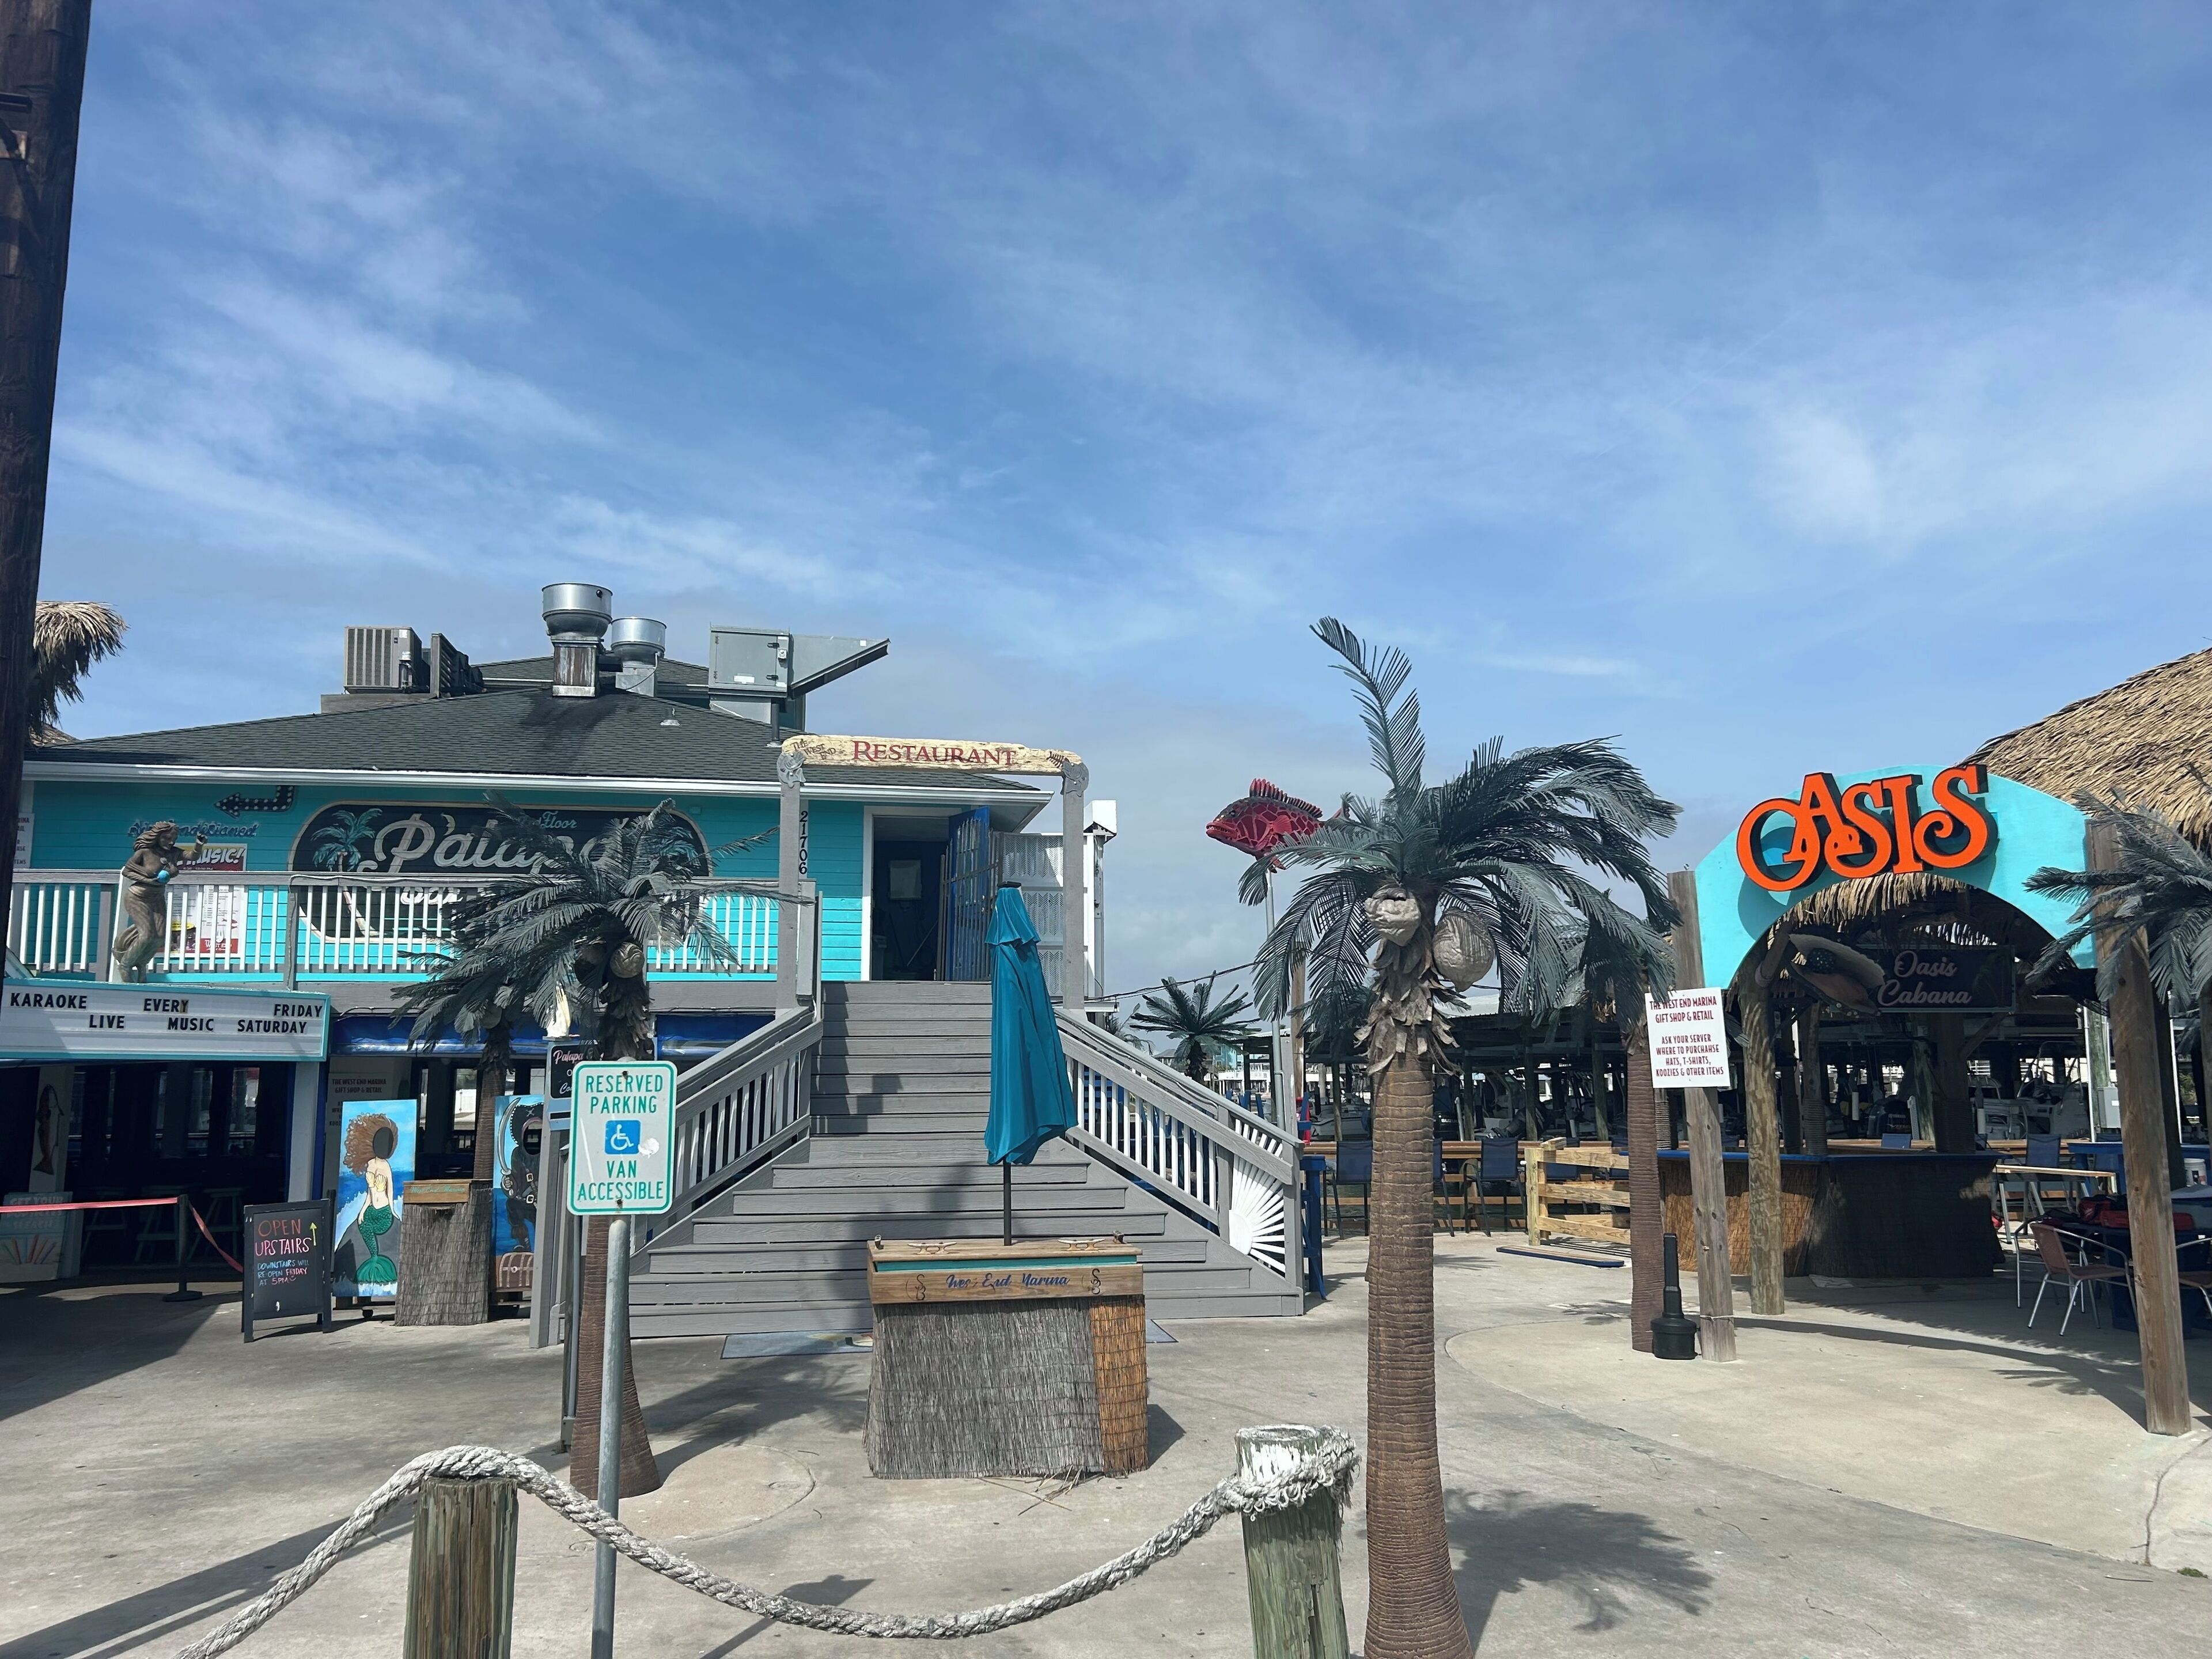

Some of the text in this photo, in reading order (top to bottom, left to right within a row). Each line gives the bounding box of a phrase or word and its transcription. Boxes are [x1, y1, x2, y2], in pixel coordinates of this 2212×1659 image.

[790, 740, 809, 752] THE
[803, 743, 825, 755] WEST
[815, 748, 836, 760] END
[851, 740, 1017, 766] RESTAURANT
[541, 810, 577, 829] Floor
[1736, 764, 1988, 891] OASIS
[798, 810, 809, 874] 21706
[1894, 950, 1958, 978] Oasis
[1877, 979, 1972, 1006] Cabana
[10, 993, 323, 1018] KARAOKE EVERY FRIDAY
[1649, 996, 1717, 1010] THE WEST END MARINA
[89, 1014, 308, 1033] LIVE MUSIC SATURDAY
[1655, 1010, 1714, 1024] GIFT SHOP & RETAIL
[1661, 1034, 1711, 1044] ASK YOUR SERVER
[552, 1050, 584, 1065] Palapa
[1656, 1044, 1719, 1056] WHERE TO PURCHAHSE
[1665, 1056, 1711, 1067] HATS, T-SHIRTS,
[1656, 1066, 1724, 1077] KOOZIES & OTHER ITEMS
[585, 1074, 663, 1093] RESERVED
[590, 1095, 658, 1114] PARKING
[606, 1160, 637, 1179] VAN
[577, 1181, 664, 1201] ACCESSIBLE
[258, 1218, 302, 1237] OPEN
[255, 1237, 312, 1256] UPSTAIRS
[257, 1259, 296, 1270] DOWNSTAIRS
[286, 1267, 308, 1276] FRIDAY
[271, 1277, 289, 1285] 5PM
